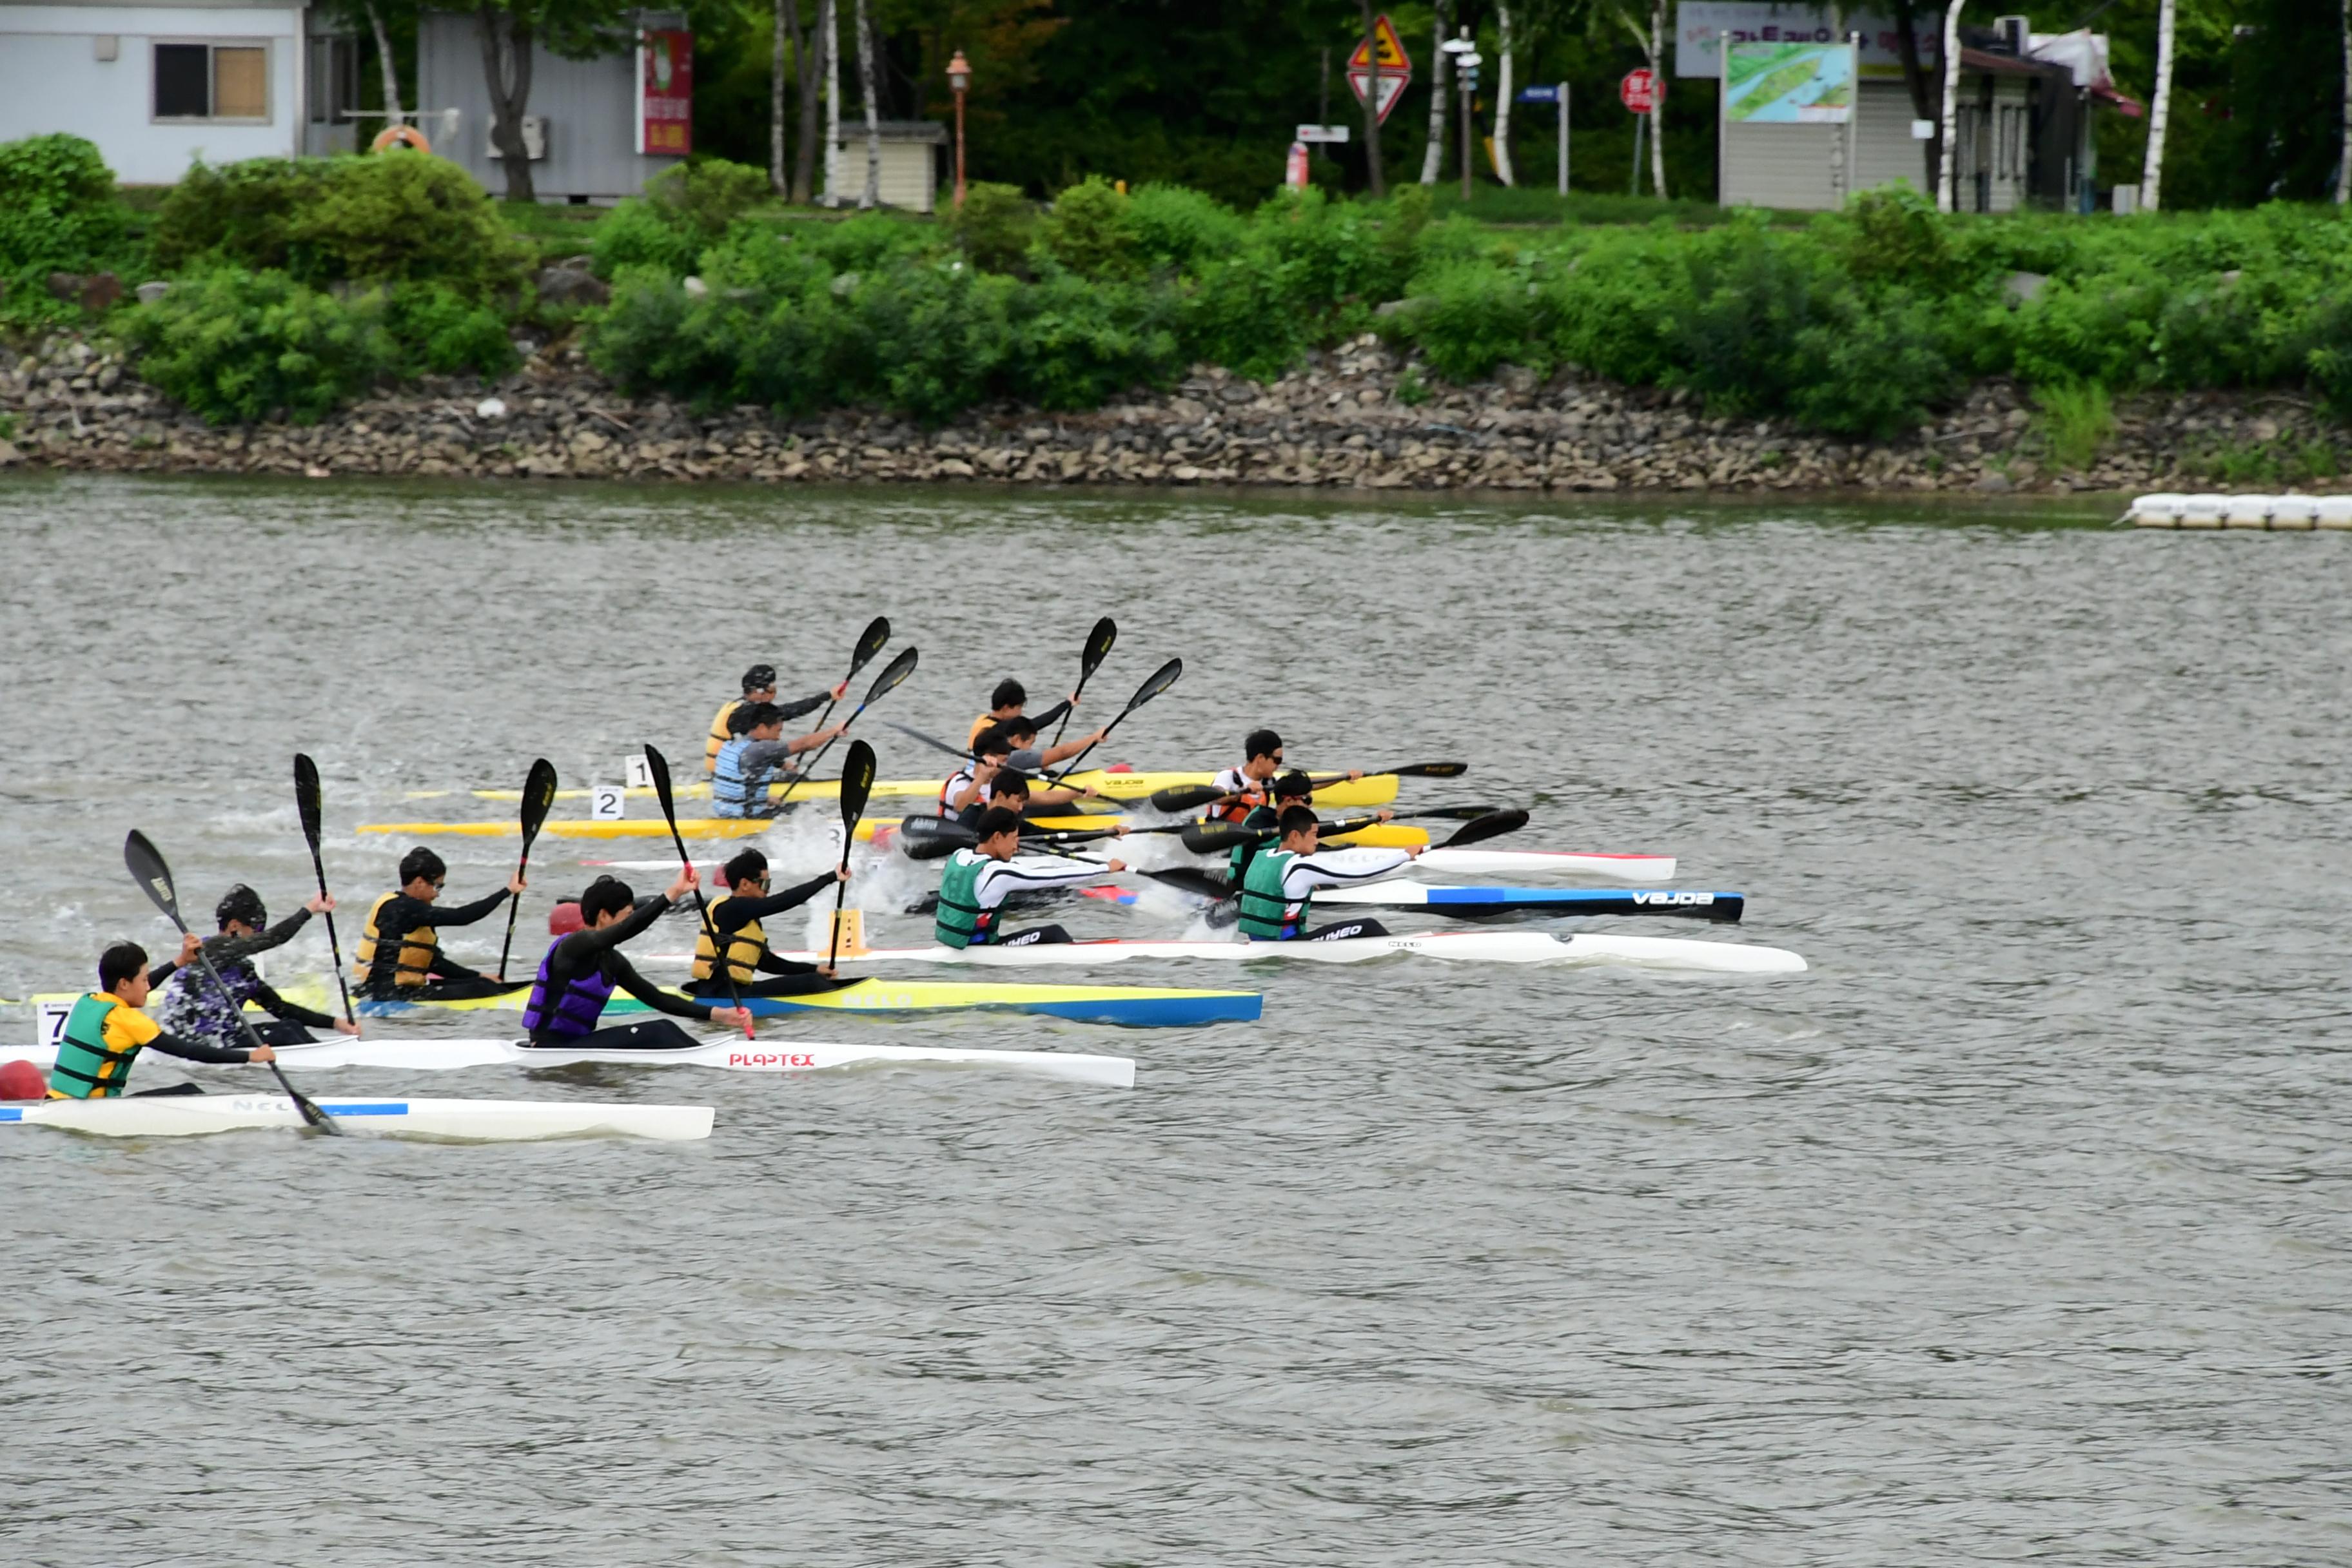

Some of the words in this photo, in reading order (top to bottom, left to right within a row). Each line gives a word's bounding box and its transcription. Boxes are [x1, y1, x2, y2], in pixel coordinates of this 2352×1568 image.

[636, 763, 645, 781] 1
[600, 794, 616, 814] 2
[842, 994, 911, 1006] NELO
[46, 1011, 68, 1037] 7
[232, 1099, 289, 1112] NEL
